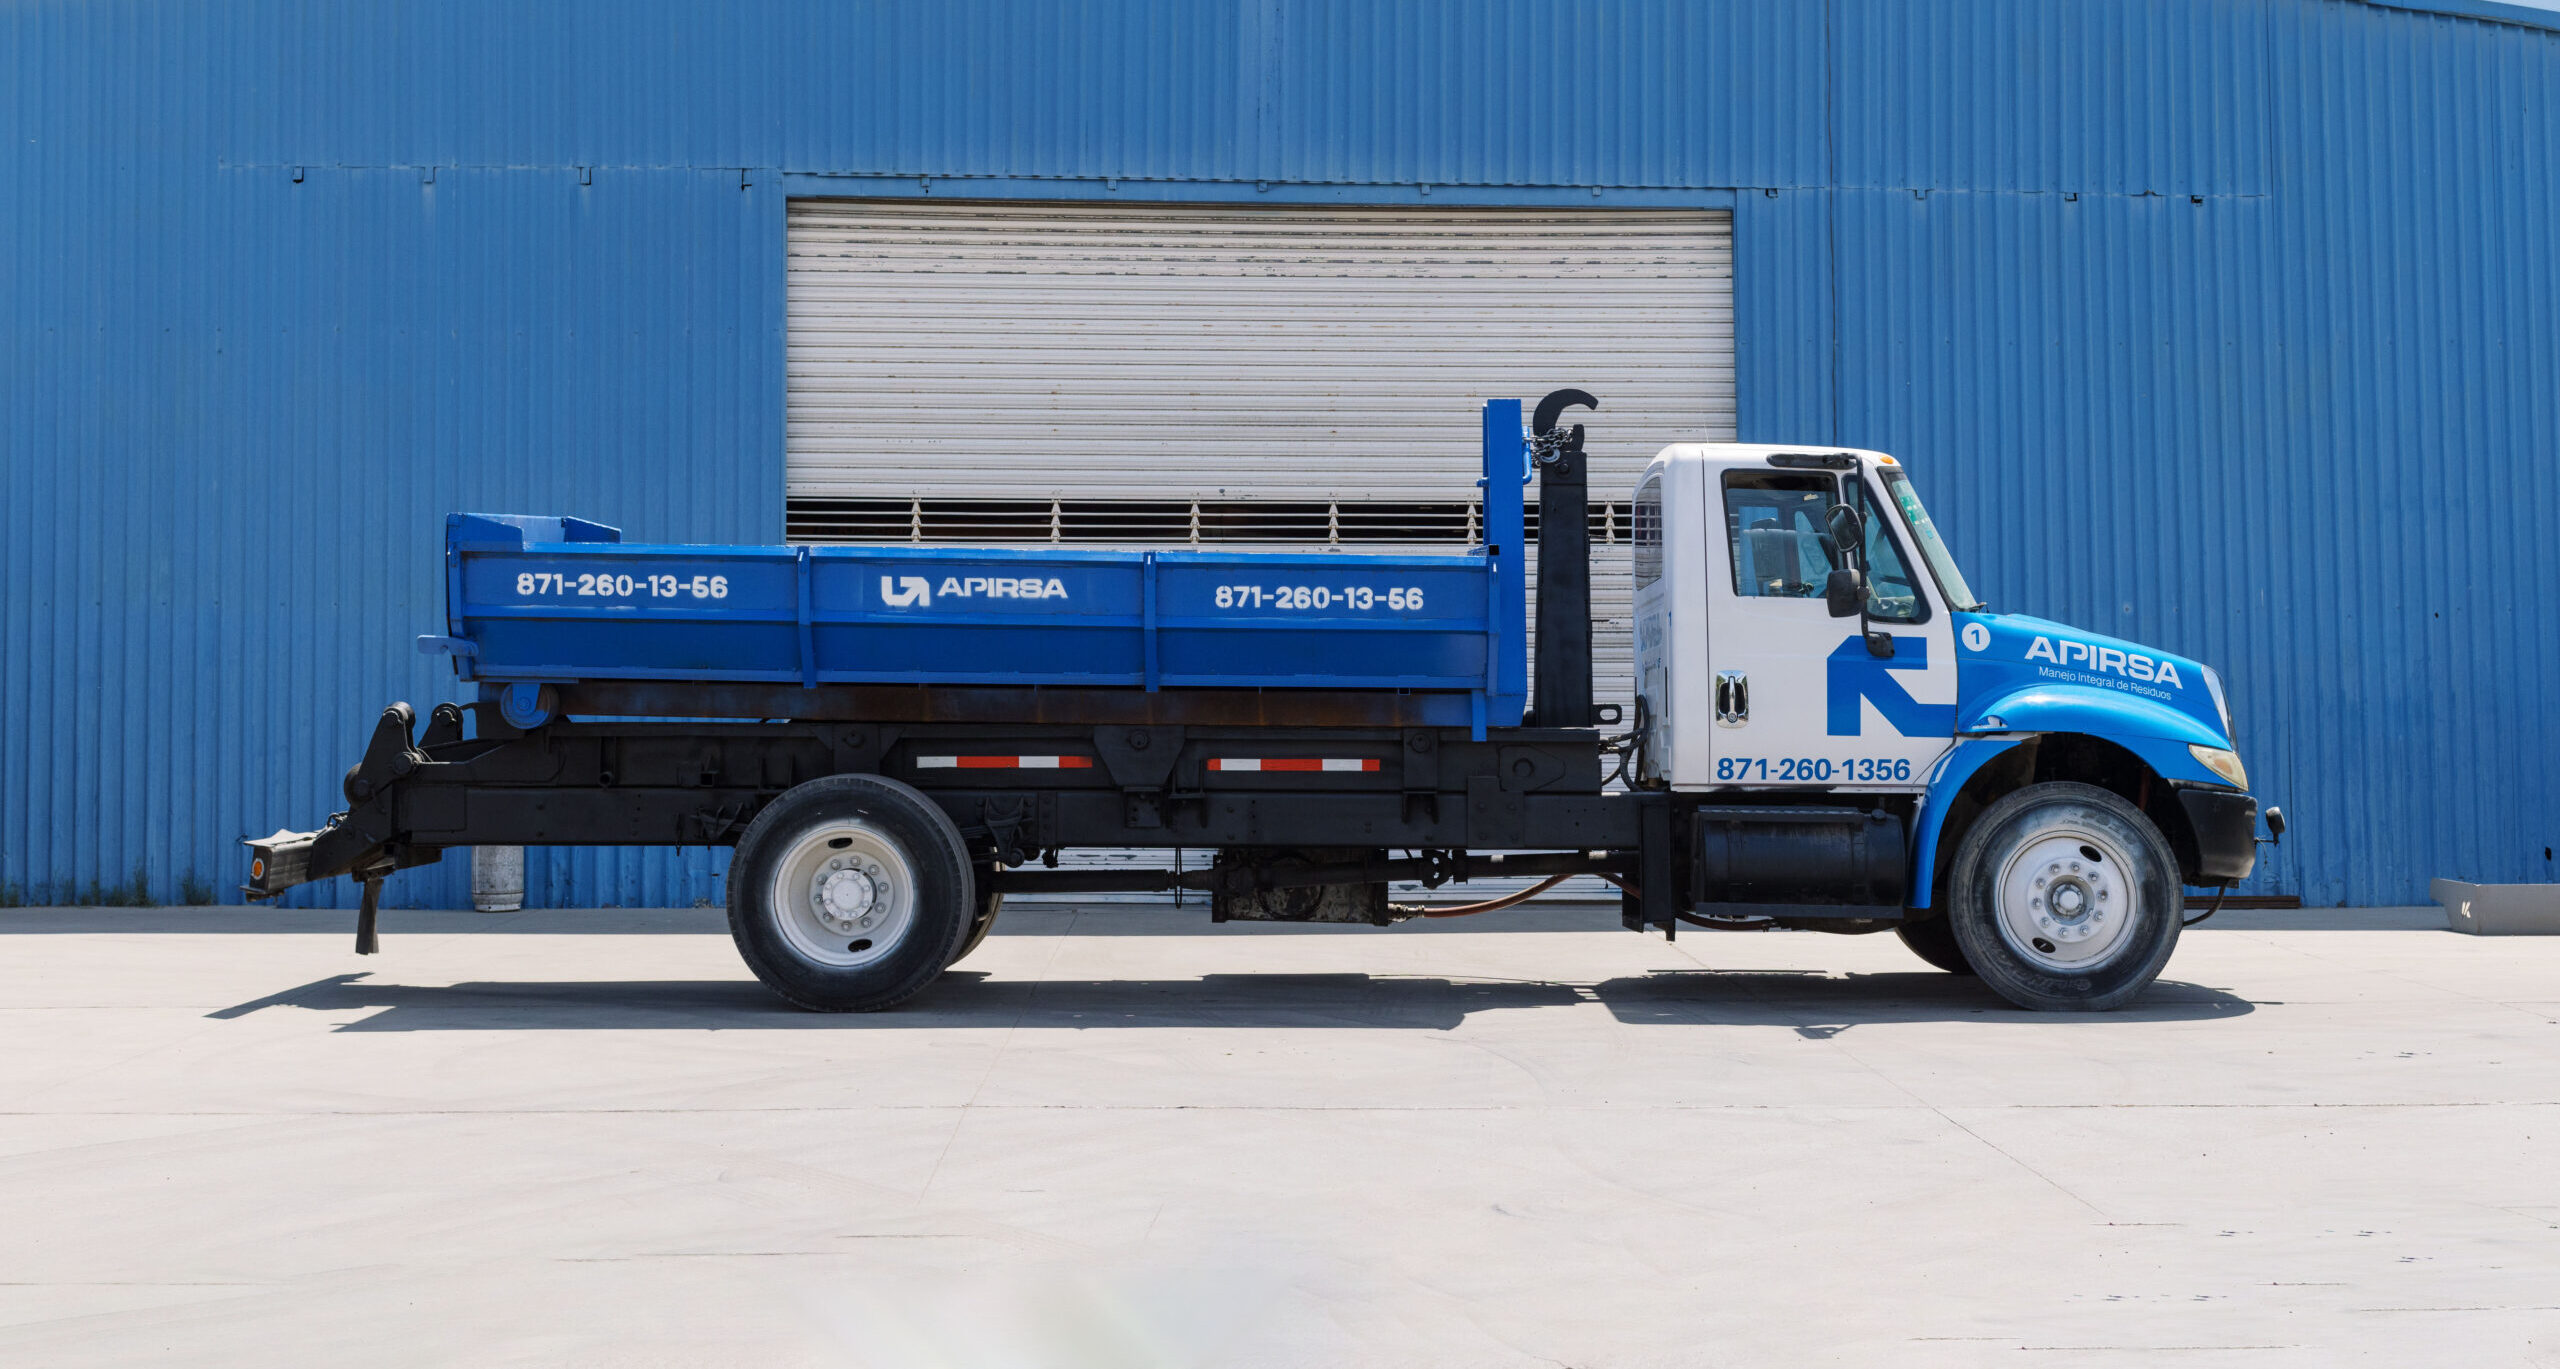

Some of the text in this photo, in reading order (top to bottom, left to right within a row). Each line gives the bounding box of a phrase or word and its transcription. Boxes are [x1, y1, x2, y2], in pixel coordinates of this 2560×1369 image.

[516, 572, 729, 599] 871-260-13-56
[937, 577, 1069, 599] APIRSA
[1214, 585, 1424, 610] 871-260-13-56
[1970, 629, 1981, 645] 1
[2024, 636, 2183, 689] APIRSA
[2039, 666, 2172, 700] Manejo Integral de Residuos
[1717, 757, 1911, 781] 871-260-1356
